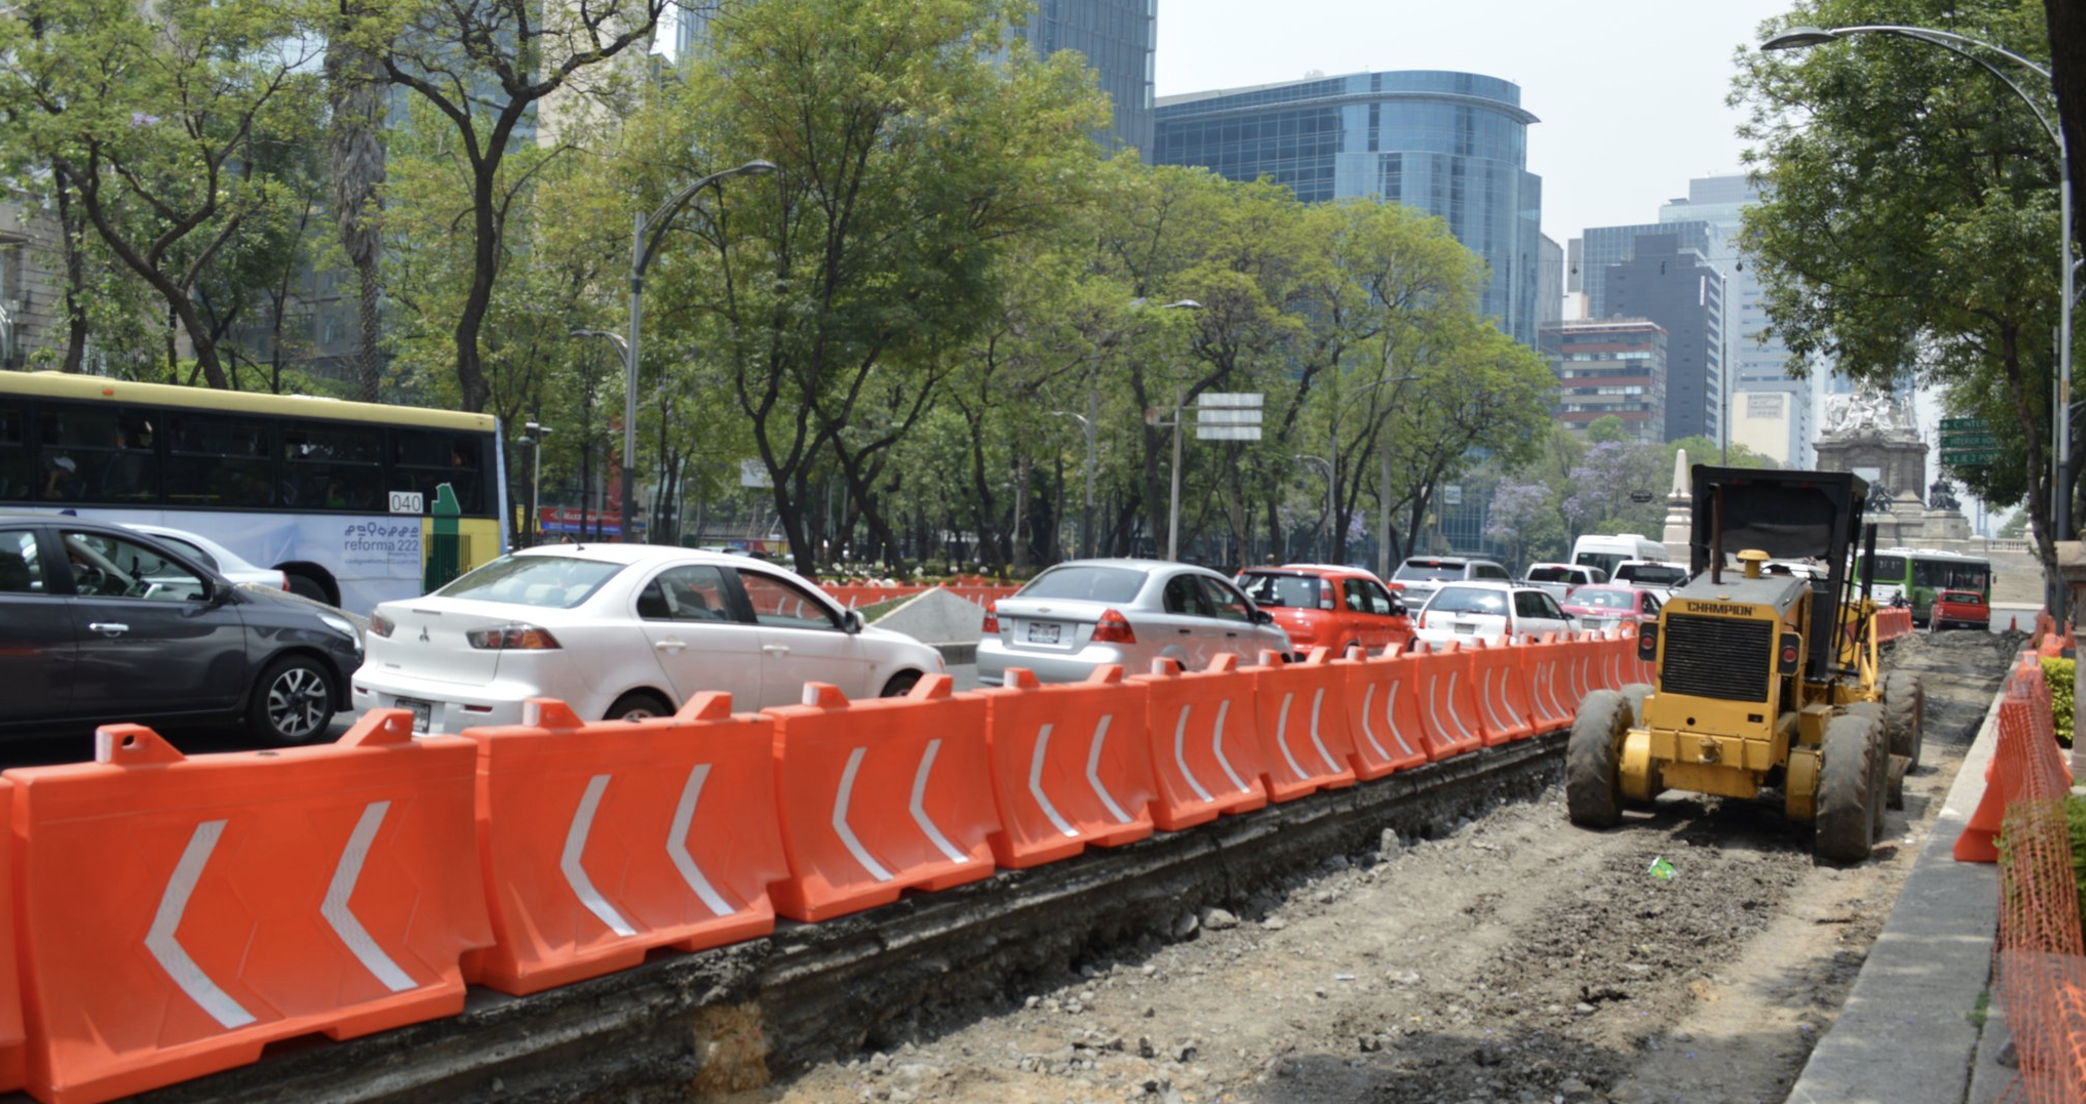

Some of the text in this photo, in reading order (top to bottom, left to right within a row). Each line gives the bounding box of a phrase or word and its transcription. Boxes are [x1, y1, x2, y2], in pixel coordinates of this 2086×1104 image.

[392, 494, 421, 512] 040
[345, 537, 419, 551] reforma 222
[1687, 601, 1752, 616] CHAMPION
